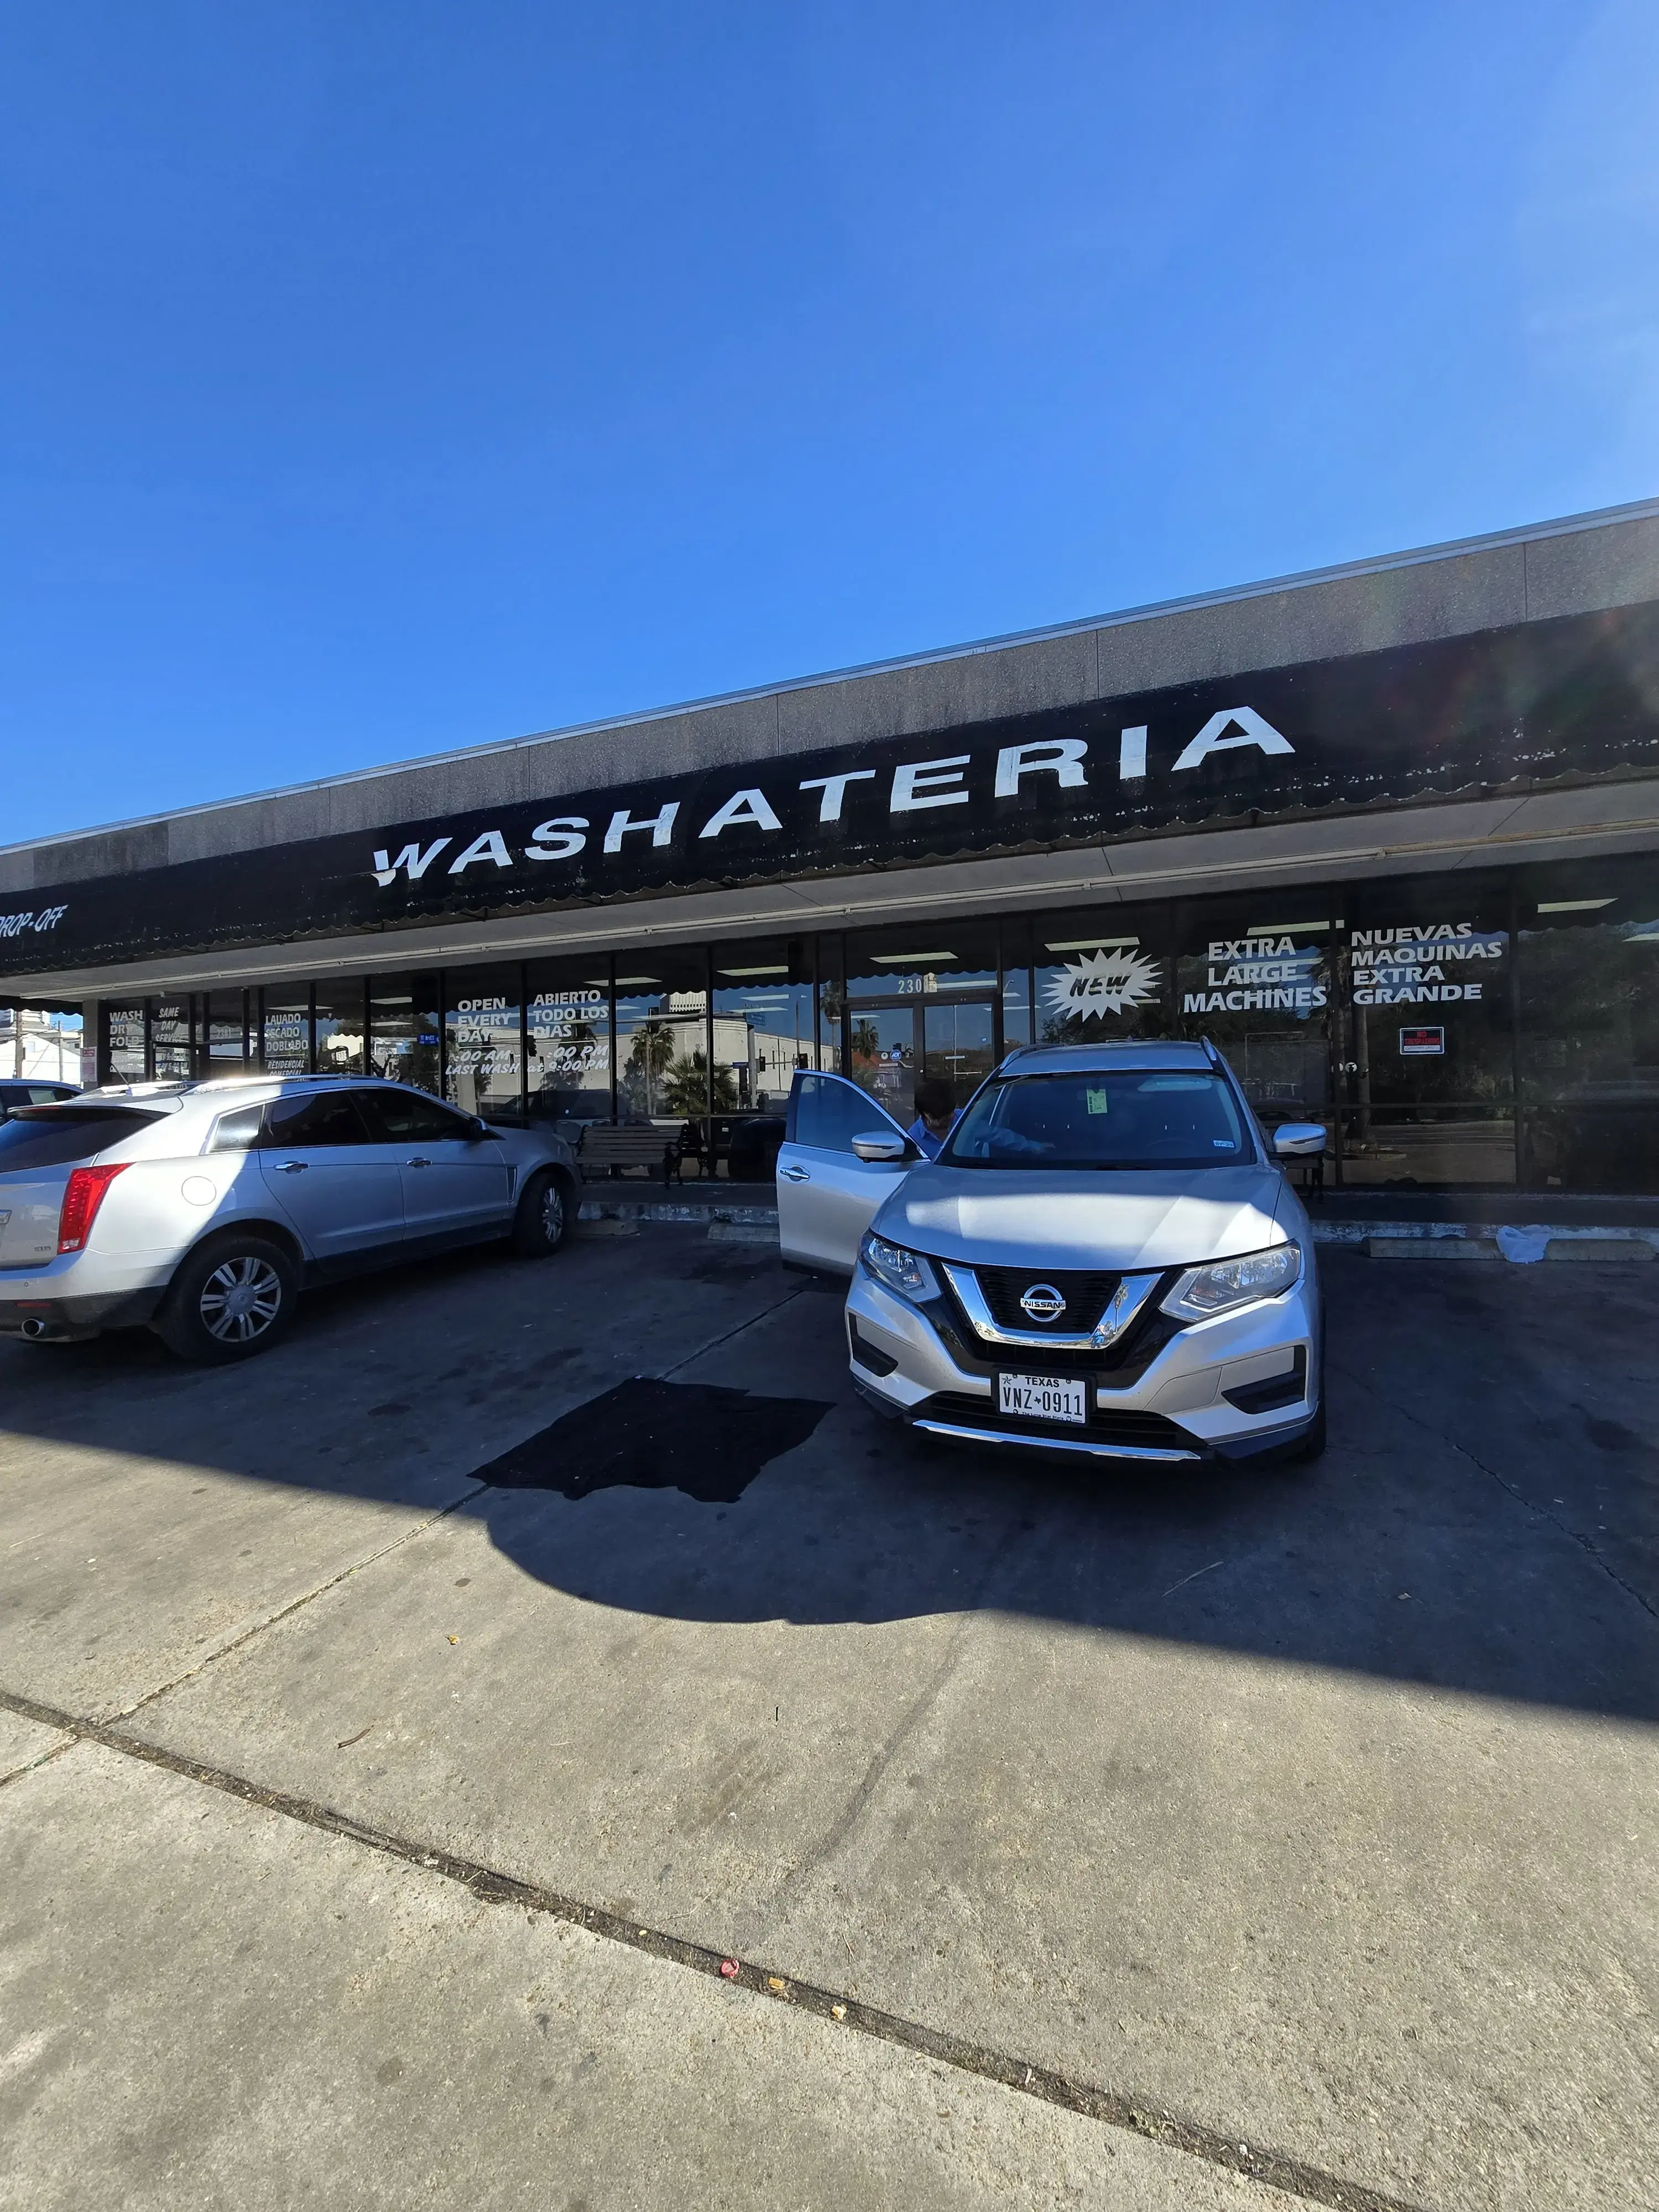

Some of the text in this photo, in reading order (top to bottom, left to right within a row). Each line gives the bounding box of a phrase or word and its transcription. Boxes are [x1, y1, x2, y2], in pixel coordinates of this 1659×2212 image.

[371, 706, 1296, 887] WASHATERIA
[1351, 922, 1472, 947] NUEVAS
[1208, 936, 1296, 961] EXTRA
[1351, 942, 1503, 967] MAQUINAS
[1208, 962, 1297, 987] LARGE
[1354, 966, 1445, 985] EXTRA
[1070, 972, 1132, 998] NEW
[533, 990, 601, 1007] ABIERTO
[1183, 987, 1327, 1013] MACHINES
[1353, 983, 1483, 1005] GRANDE
[158, 1006, 180, 1018] SAME
[457, 997, 506, 1013] OPEN
[109, 1010, 143, 1022] WASH
[457, 1013, 512, 1027] EVERY
[533, 1005, 609, 1022] TODO LOS
[109, 1024, 133, 1035] DRY
[160, 1020, 177, 1031] DAY
[265, 1026, 300, 1038] SECADO
[533, 1024, 572, 1038] DIAS
[109, 1036, 139, 1047] FOLD
[457, 1029, 492, 1043] DAY
[266, 1039, 309, 1052] DOBLADO
[484, 1050, 512, 1061] AM
[580, 1045, 609, 1057] PM
[445, 1065, 479, 1075] LAST
[480, 1062, 521, 1074] WASH
[527, 1063, 545, 1073] at
[585, 1059, 609, 1071] PM
[1024, 1300, 1061, 1309] NISSAN
[1025, 1376, 1060, 1388] TEXAS
